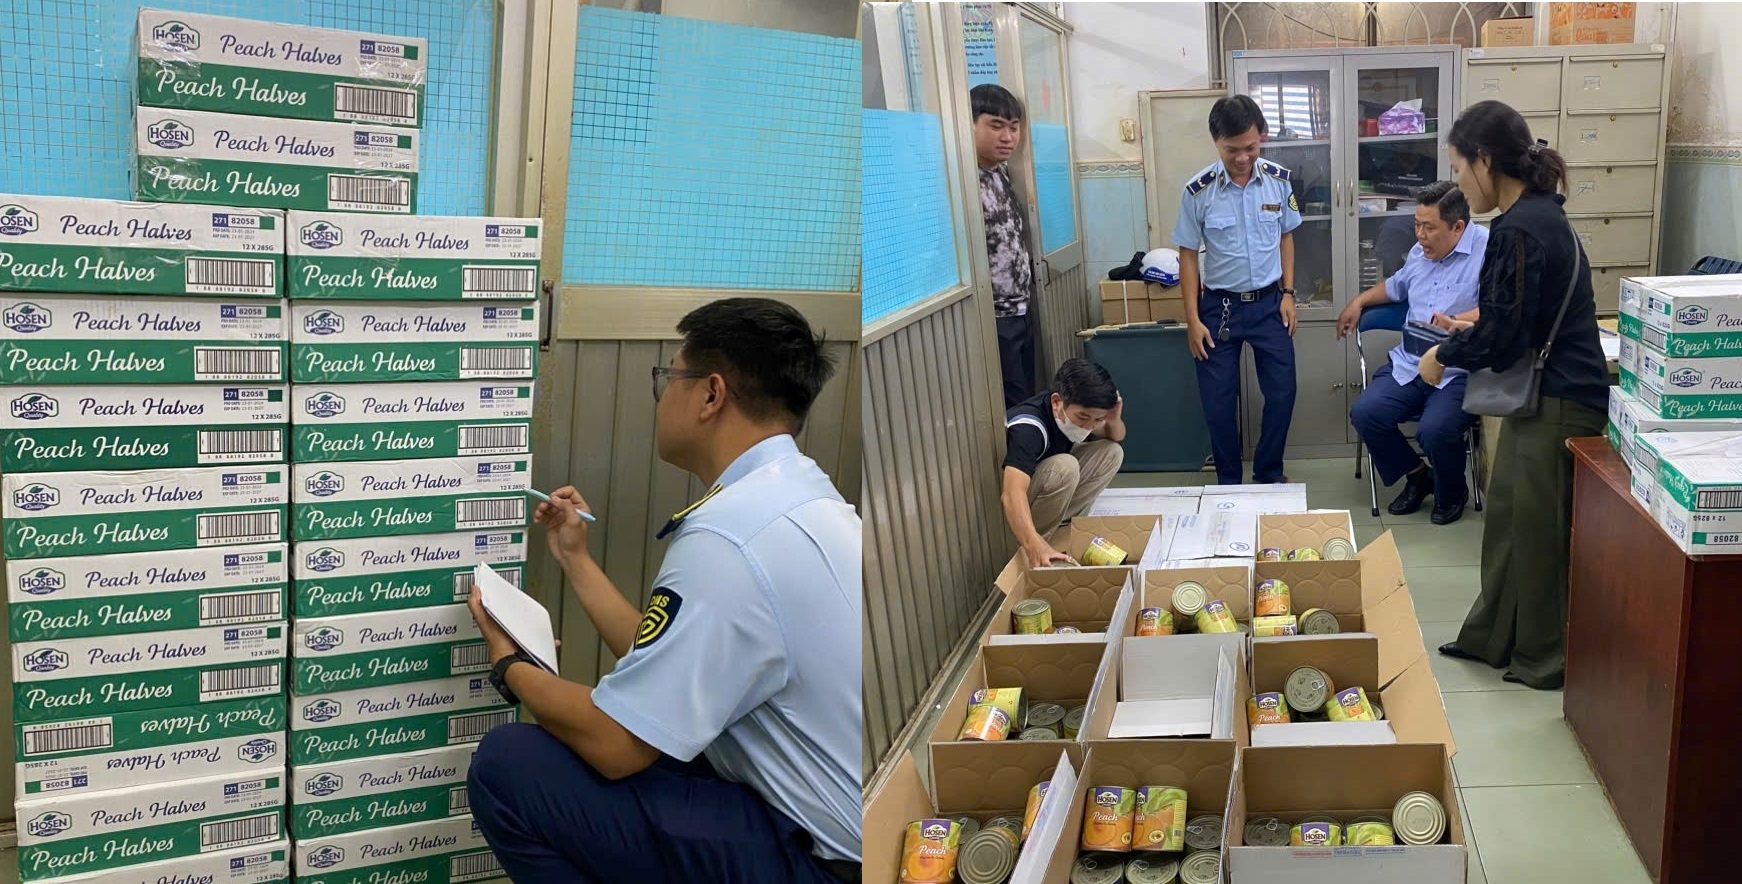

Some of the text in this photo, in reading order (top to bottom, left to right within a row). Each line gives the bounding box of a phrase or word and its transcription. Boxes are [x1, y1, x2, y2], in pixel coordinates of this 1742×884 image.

[220, 34, 342, 66] Peach Halves
[362, 43, 400, 54] 271 82058
[156, 69, 307, 106] Peach Halves
[150, 127, 189, 141] HOSEN
[214, 130, 335, 157] Peach Halves
[151, 166, 300, 197] Peach Halves
[0, 215, 32, 227] OSEN
[60, 215, 121, 236] Peach
[127, 219, 192, 241] Halves
[303, 230, 338, 242] HOSEN
[486, 227, 498, 235] 271
[360, 230, 469, 250] Peach Halves
[0, 253, 156, 281] Peach Halves
[303, 265, 437, 289] Peach Halves
[6, 313, 46, 325] HOSEN
[222, 308, 234, 316] 271
[1716, 314, 1742, 327] Pea
[73, 311, 201, 332] Peach Halves
[306, 318, 340, 328] HOSEN
[361, 316, 466, 332] Peach Halves
[1675, 337, 1742, 353] Peach Hal
[7, 349, 165, 372] Peach Halves
[306, 352, 436, 372] Peach Halves
[1710, 377, 1742, 389] Peac
[14, 401, 53, 411] HOSEN
[79, 398, 205, 416] Peach Halves
[308, 401, 341, 410] HOSEN
[362, 397, 465, 414] Peach Halves
[1669, 399, 1742, 413] Peach Halve
[14, 436, 169, 459] Peach Halves
[307, 431, 434, 452] Peach Halves
[16, 492, 55, 503] HOSEN
[80, 486, 203, 505] Peach Halves
[17, 523, 169, 548] Peach Halves
[309, 555, 340, 566] HOSEN
[361, 547, 460, 566] Peach Halves
[22, 577, 60, 588] HOSEN
[85, 568, 206, 589] Peach Halves
[307, 582, 431, 605] Peach Halves
[22, 605, 172, 630] Peach Halves
[305, 706, 337, 717] HOSEN
[357, 694, 455, 714] Peach Halves
[141, 708, 276, 735] Peach Halves
[305, 729, 426, 754] Peach Halves
[107, 747, 221, 771] Peach Halves
[242, 745, 275, 756] HOSEN
[46, 780, 70, 788] 82058
[308, 779, 339, 790] HOSEN
[359, 766, 456, 788] Peach Halves
[91, 801, 206, 826] Peach Halves
[306, 801, 427, 828] Peach Halves
[1093, 812, 1118, 820] Peach
[30, 818, 67, 832] HOSEN
[1305, 832, 1326, 841] HOSEN
[30, 838, 174, 870] Peach Halves
[360, 835, 456, 859] Peach Halves
[920, 845, 946, 854] Peach
[310, 852, 341, 863] HOSEN
[369, 870, 428, 884] Halves
